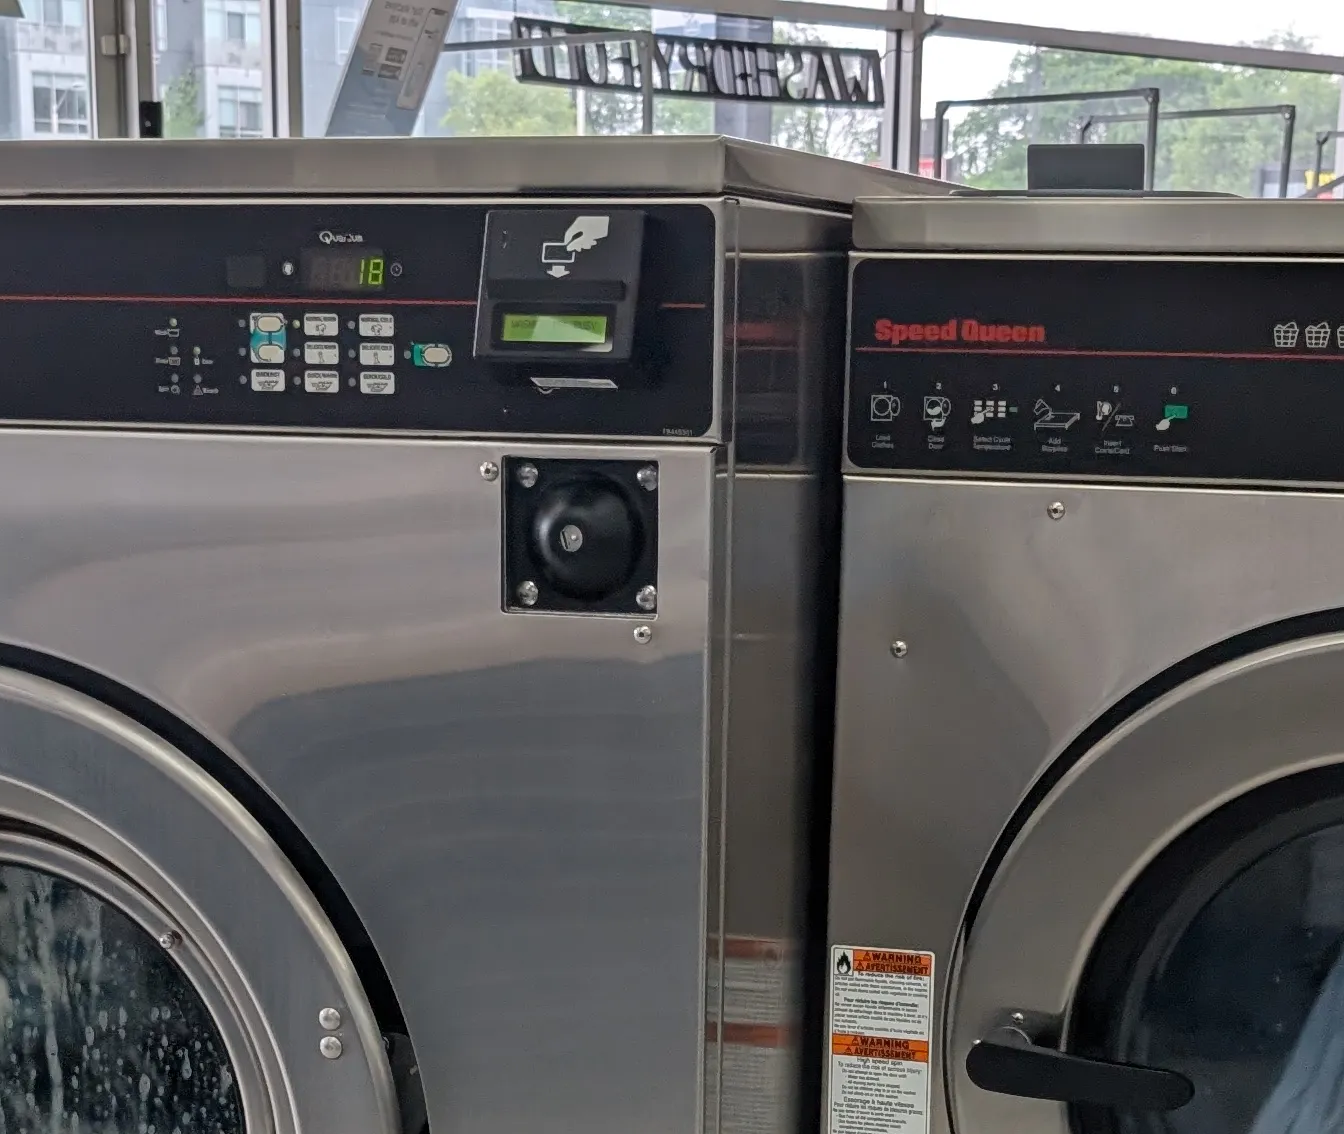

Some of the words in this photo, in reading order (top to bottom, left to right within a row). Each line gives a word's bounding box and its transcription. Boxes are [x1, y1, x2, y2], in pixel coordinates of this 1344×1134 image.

[358, 258, 385, 286] 18
[874, 318, 958, 345] Speed
[961, 319, 1046, 343] Queen
[860, 1037, 909, 1049] WARNING
